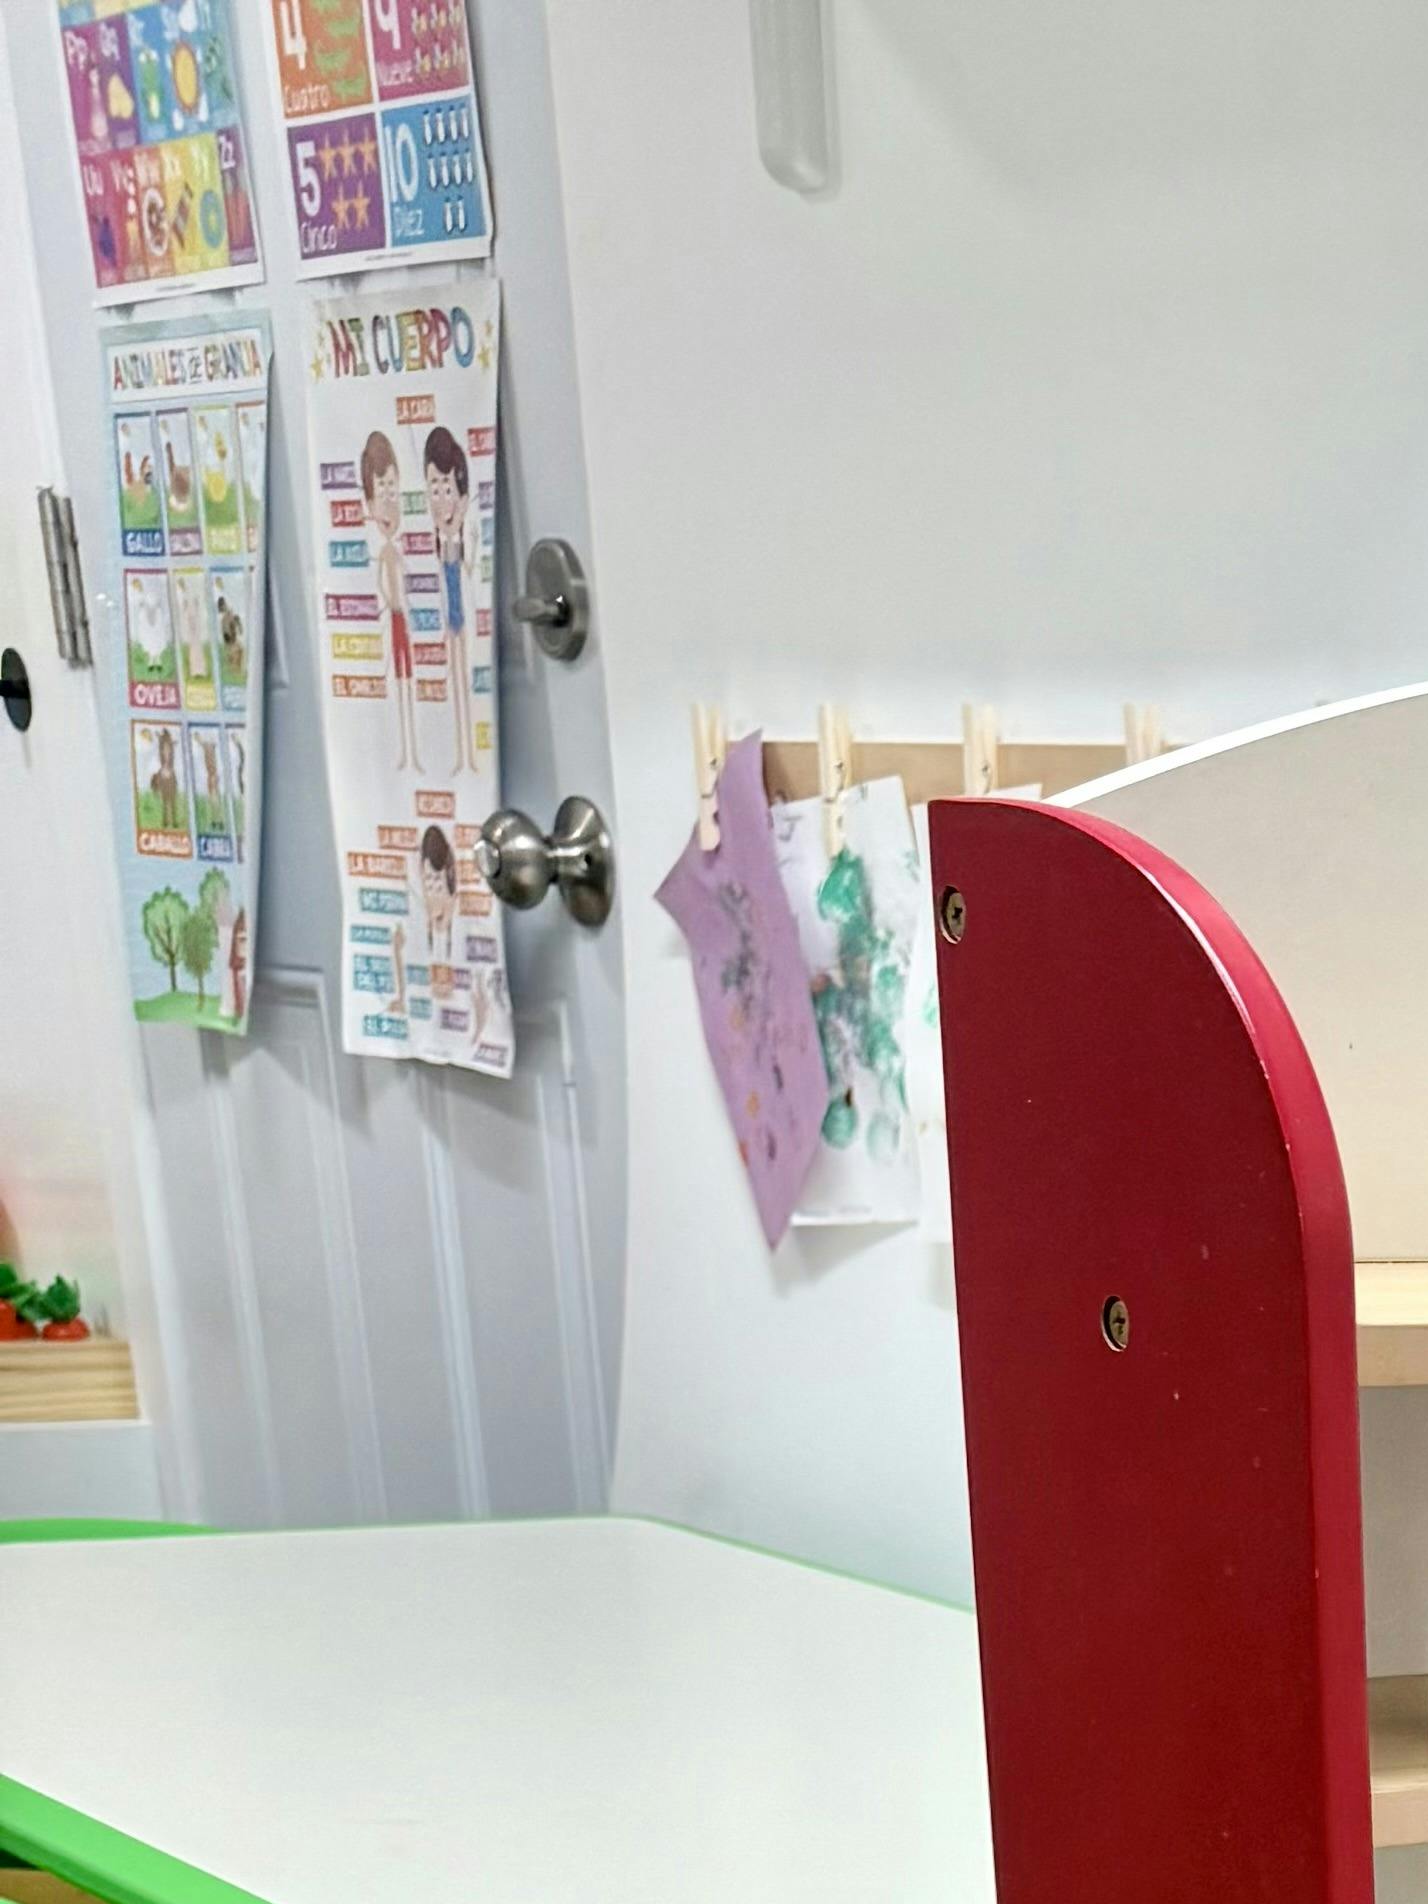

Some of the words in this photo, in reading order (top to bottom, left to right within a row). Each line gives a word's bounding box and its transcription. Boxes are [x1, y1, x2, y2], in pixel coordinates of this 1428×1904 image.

[280, 0, 307, 70] 4
[284, 85, 331, 113] Cuatro
[296, 141, 321, 217] 5
[385, 122, 419, 203] 10
[301, 221, 337, 253] Cinco
[327, 318, 370, 378] MI
[372, 306, 475, 374] CUERPO
[114, 349, 186, 390] ANIMALES
[204, 339, 262, 381] GRANJA
[127, 532, 162, 553] GALLO
[134, 683, 176, 706] OVEJA
[139, 831, 191, 856] CABALLO
